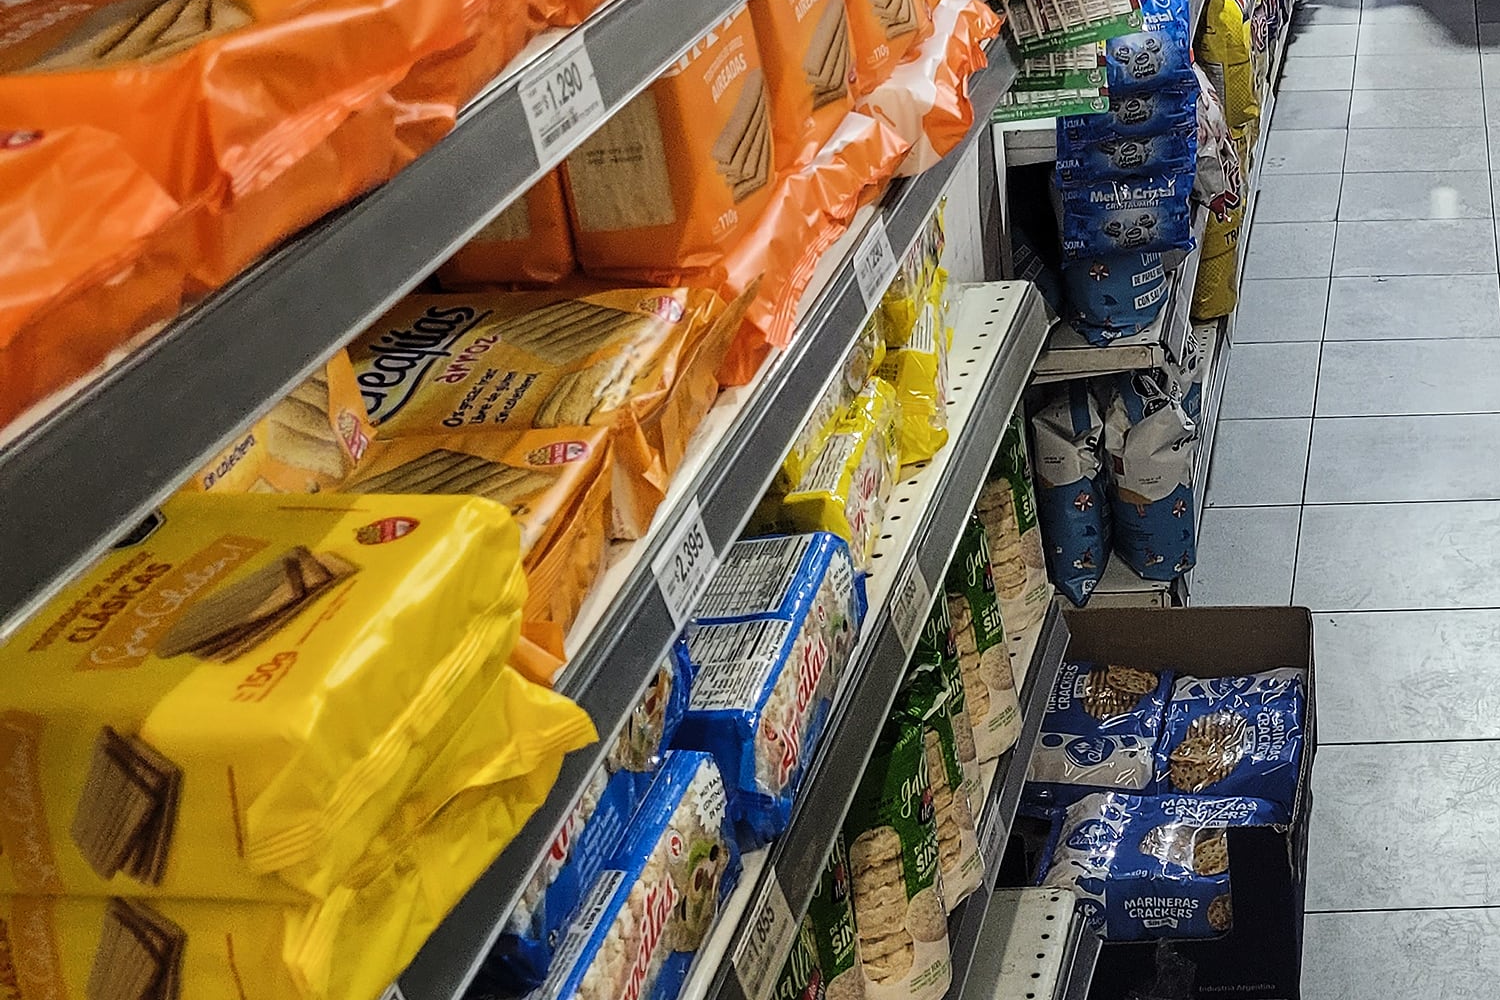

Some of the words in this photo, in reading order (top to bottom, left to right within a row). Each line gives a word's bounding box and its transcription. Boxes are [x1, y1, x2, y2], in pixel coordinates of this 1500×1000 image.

[1143, 12, 1173, 25] ristal
[710, 52, 747, 103] AIREADAS
[67, 562, 172, 643] CLÁSICAS
[1124, 897, 1199, 909] MARINERAS
[1129, 907, 1193, 920] CRACKERS
